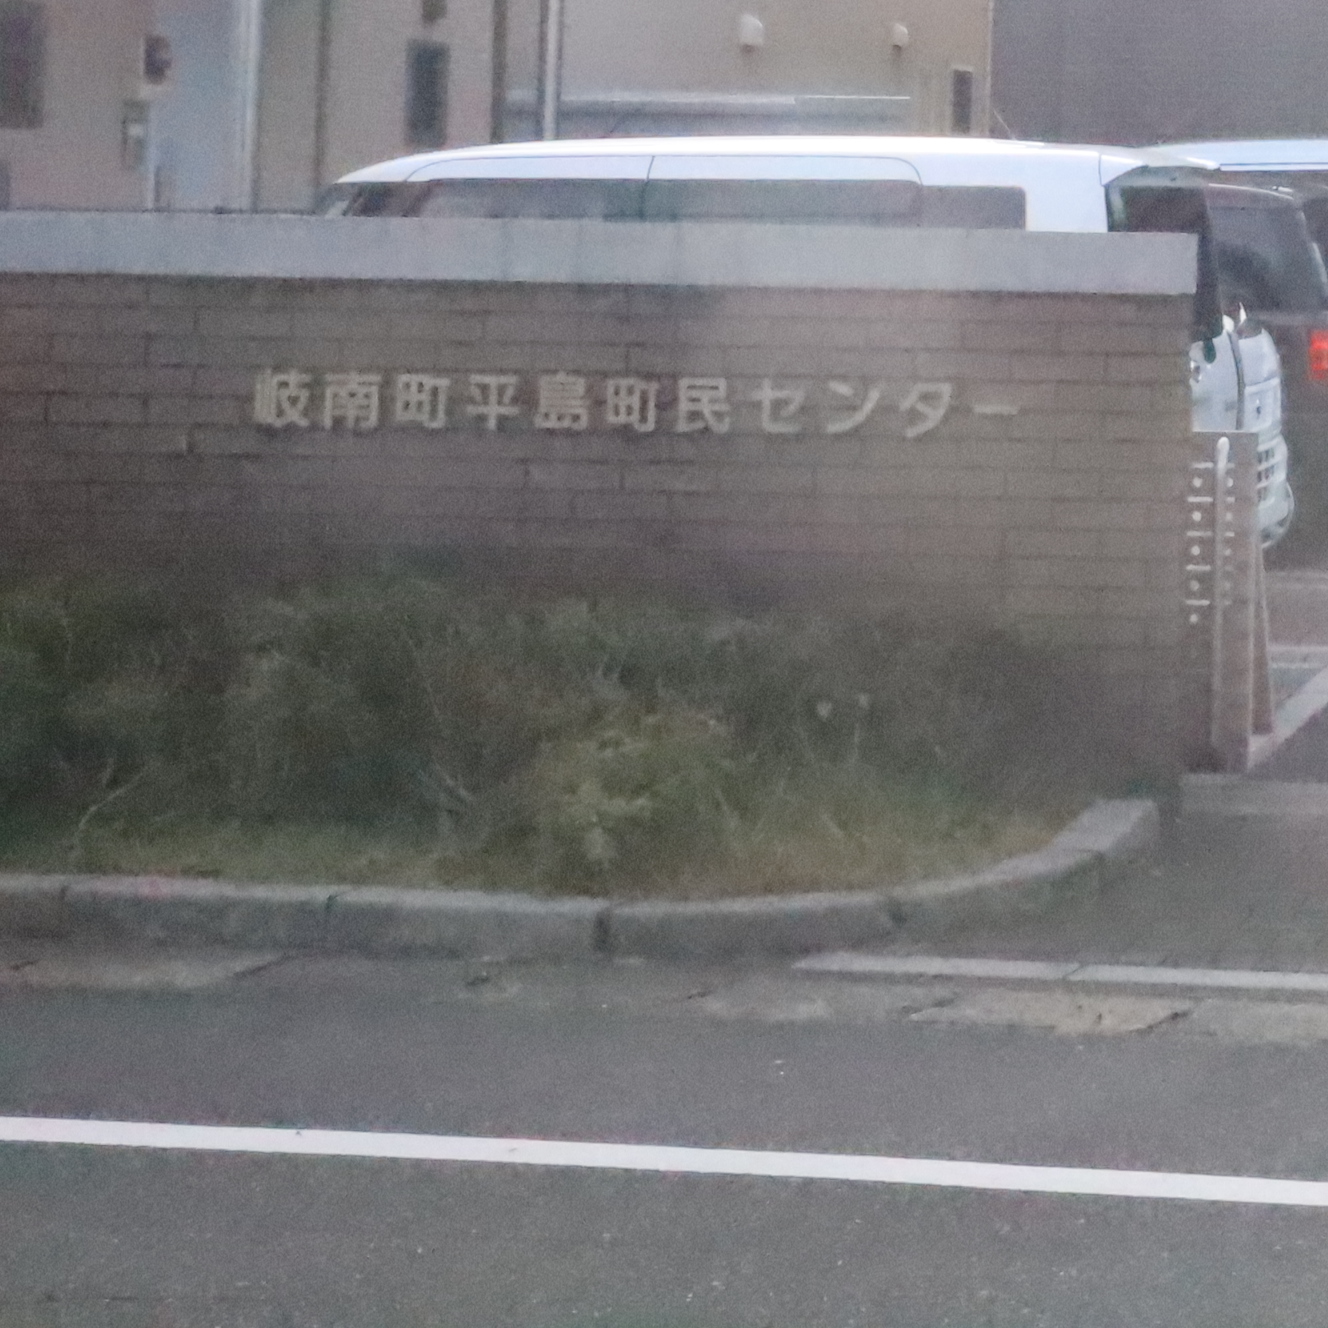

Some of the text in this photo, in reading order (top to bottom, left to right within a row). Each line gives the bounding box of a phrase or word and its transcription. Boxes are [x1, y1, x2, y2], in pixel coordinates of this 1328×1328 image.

[253, 369, 1019, 438] 岐南町平島町民センター
